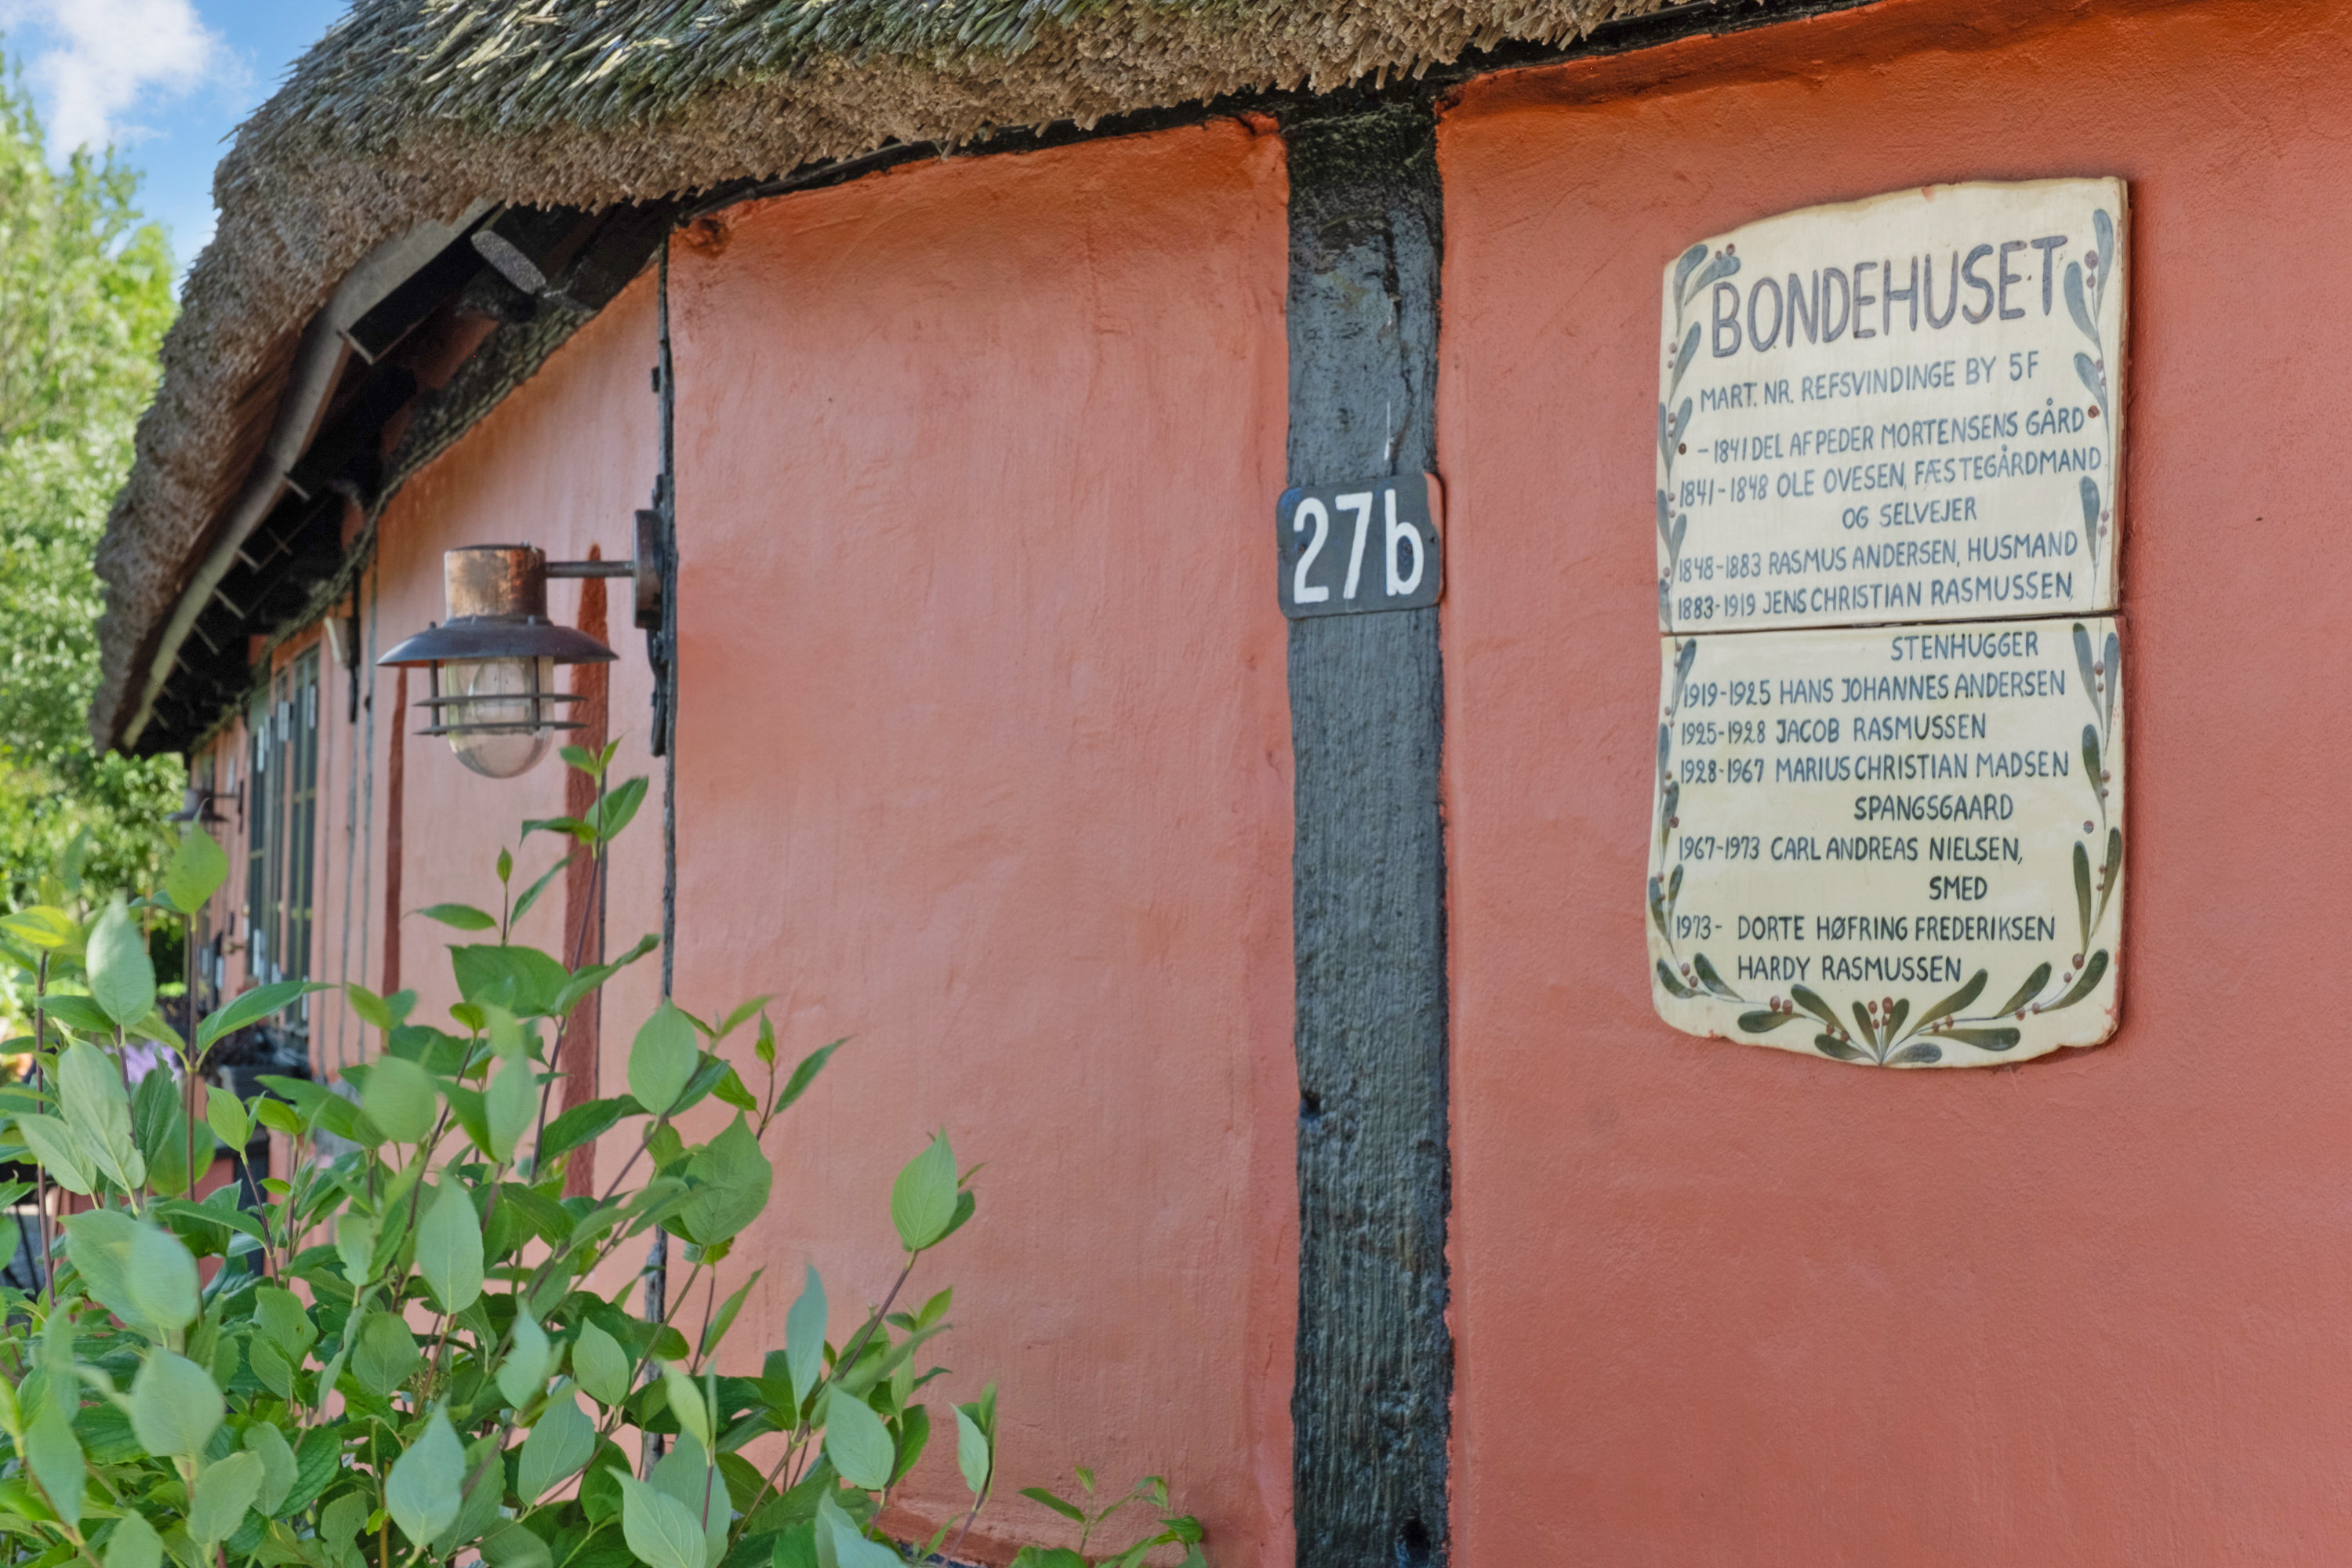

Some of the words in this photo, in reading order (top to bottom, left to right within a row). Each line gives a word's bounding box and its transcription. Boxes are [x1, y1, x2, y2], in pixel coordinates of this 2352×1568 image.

[1711, 235, 2068, 358] BONDEHUSET
[1700, 382, 1757, 412] MART.
[1764, 379, 1794, 405] NR.
[1802, 360, 1955, 401] REFSVINDINGE
[1965, 355, 1997, 385] BY
[1751, 434, 1784, 461] DEL
[1789, 430, 1813, 457] AF
[1816, 425, 1874, 455] PEDER
[1882, 410, 2018, 449] MORTENSENS
[2025, 397, 2085, 436] GÅRD
[1777, 470, 1814, 498] OLE
[1823, 461, 1907, 493] OVESEN,
[1915, 445, 2102, 485] FÆSTEGÅRDMAND
[1842, 506, 1868, 529] OG
[1879, 496, 1976, 528] SELVEJER
[1294, 488, 1425, 604] 27b
[1769, 546, 1846, 575] RASMUS
[1852, 539, 1960, 570] ANDERSEN,
[1968, 530, 2078, 562] HUSMAND
[1762, 588, 1806, 614] JENS
[1810, 580, 1922, 612] CHRISTIAN
[1931, 571, 2074, 606] RASMUSSEN,
[1890, 630, 2038, 661] STENHUGGER
[1779, 677, 1834, 705] HANS
[1842, 674, 1949, 703] JOHANNES
[1954, 669, 2065, 699] ANDERSEN
[1776, 717, 1840, 744] JACOB
[1853, 712, 1986, 742] RASMUSSEN
[1775, 755, 1851, 782] MARIUS
[1854, 753, 1968, 781] CHRISTIAN
[1976, 750, 2069, 778] MADSEN
[1853, 793, 2014, 822] SPANGSGAARD
[1770, 837, 1821, 862] CARL
[1825, 836, 1918, 861] ANDREAS
[1929, 836, 2023, 865] NIELSEN,
[1929, 876, 1988, 901] SMED
[1737, 914, 1805, 941] DORTE
[1817, 915, 1908, 941] HØFRING
[1915, 916, 2055, 942] FREDERIKSEN
[1738, 955, 1810, 982] HARDY
[1822, 955, 1962, 982] RASMUSSEN
